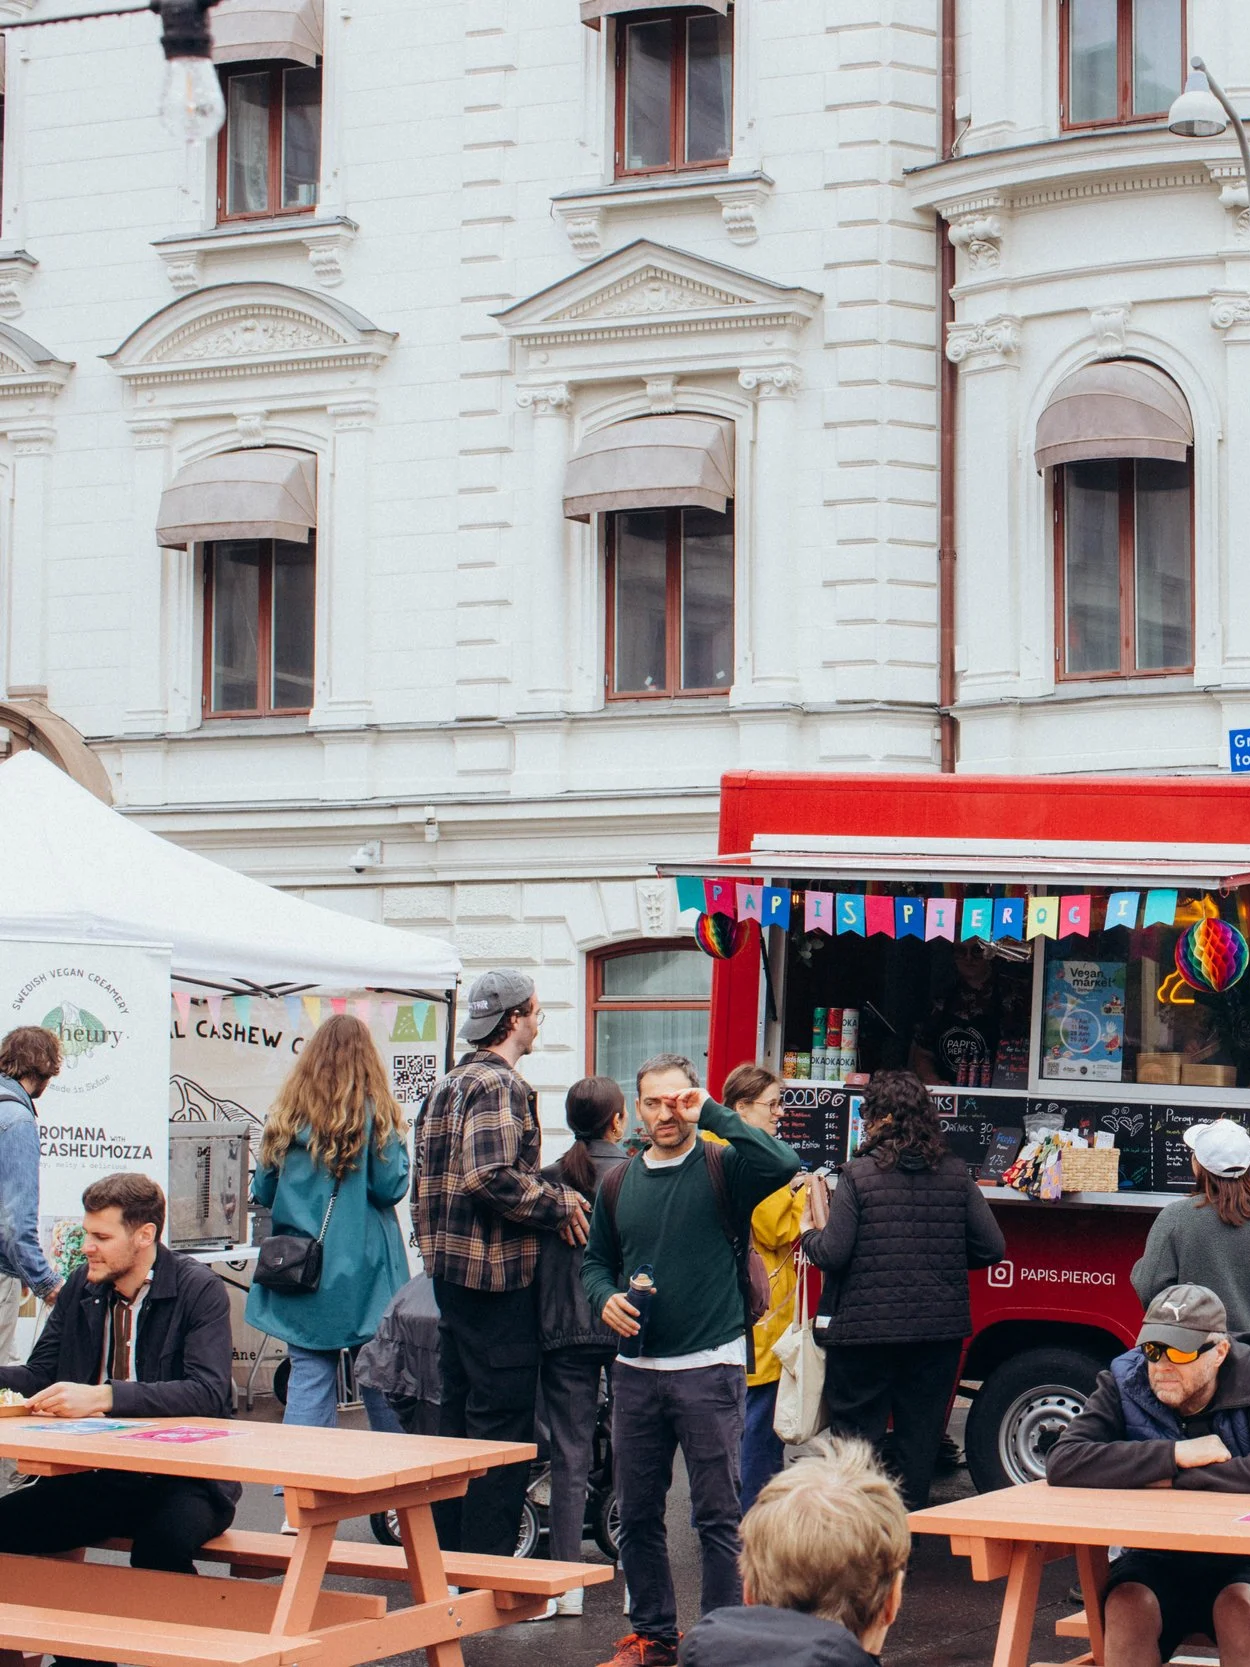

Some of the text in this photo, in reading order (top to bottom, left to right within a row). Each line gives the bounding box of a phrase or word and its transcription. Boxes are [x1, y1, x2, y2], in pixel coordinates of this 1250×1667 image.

[1070, 968, 1104, 979] Vegan
[12, 968, 129, 1015] SWEDISH VEGAN CREAMERY
[54, 1022, 123, 1048] heury
[196, 1020, 283, 1048] CASHEW
[947, 1040, 977, 1050] PAPI'S
[780, 1089, 815, 1105] OOD
[40, 1125, 106, 1141] ROMANA
[980, 1122, 993, 1133] 30
[980, 1134, 991, 1144] 25
[40, 1143, 153, 1159] CASHEUMOZZA
[1021, 1268, 1116, 1286] PAPIS.PIEROGI
[232, 1347, 257, 1360] åne
